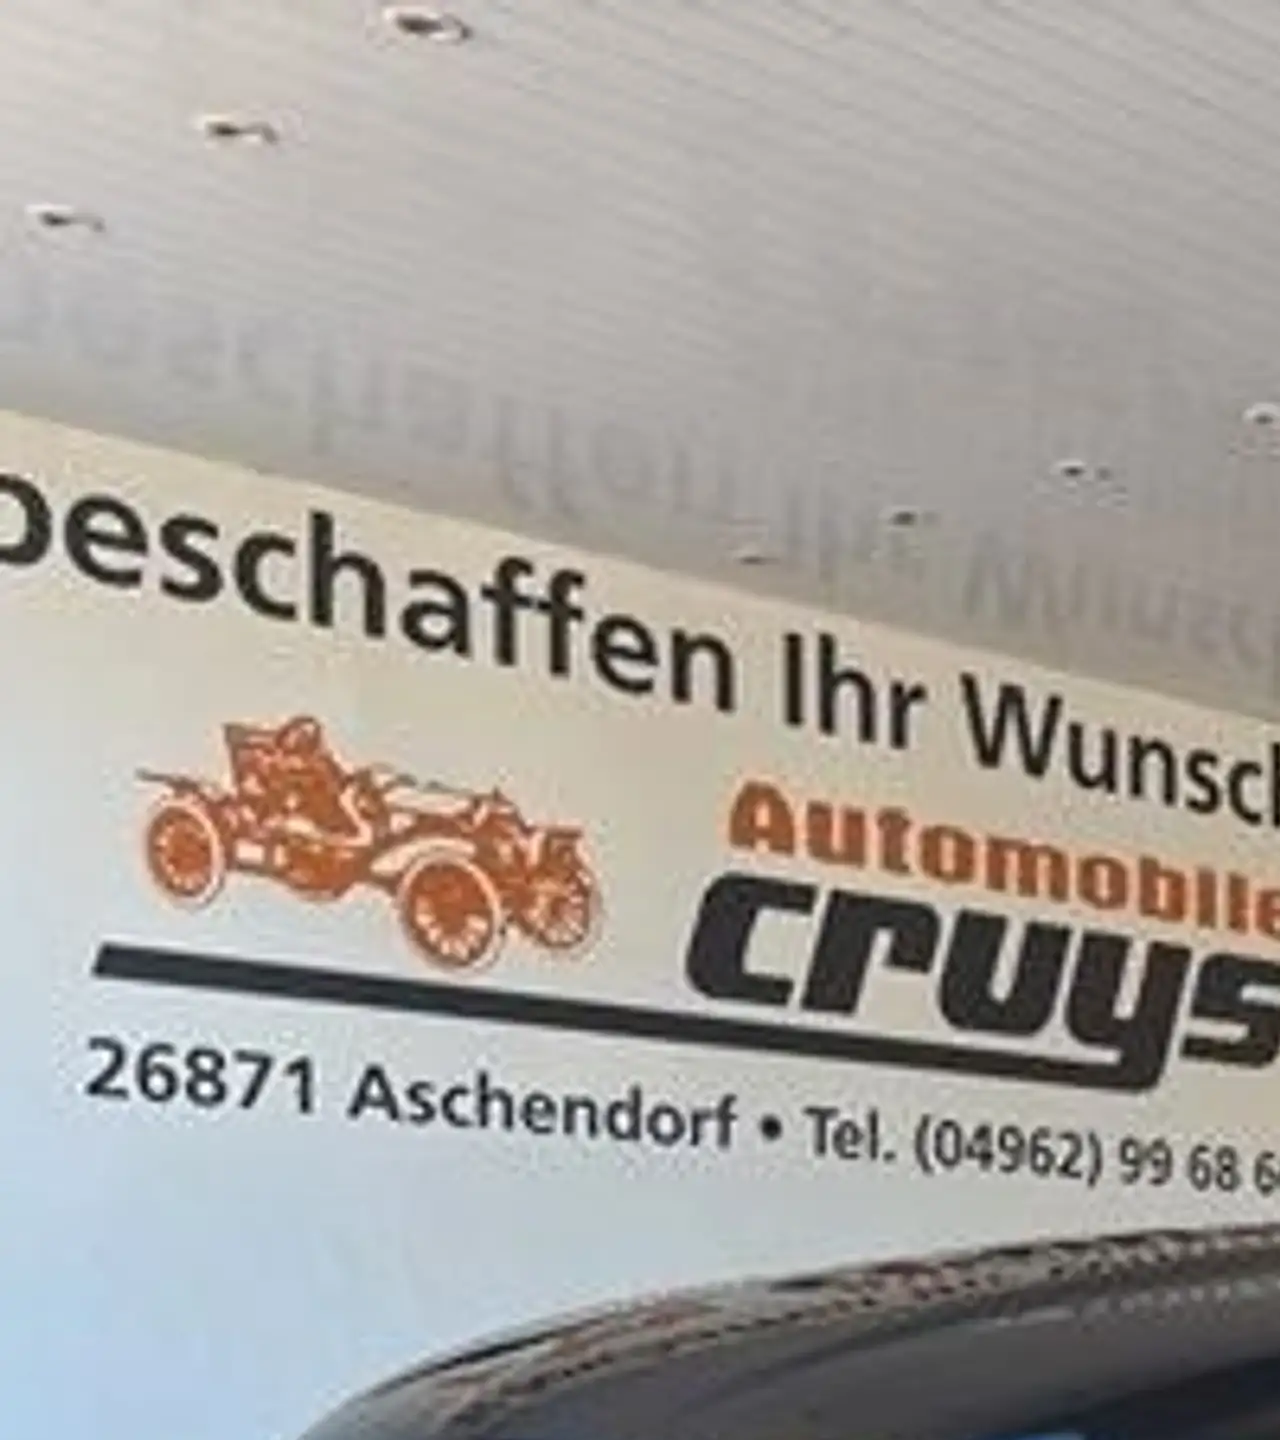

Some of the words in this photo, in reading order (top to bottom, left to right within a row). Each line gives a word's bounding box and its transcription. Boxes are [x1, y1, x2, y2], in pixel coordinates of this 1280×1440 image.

[783, 631, 926, 750] Ihr
[84, 1035, 317, 1114] 26871
[347, 1064, 738, 1150] Aschendorf
[804, 1106, 895, 1163] Tel.
[913, 1114, 1102, 1187] (04962)
[1119, 1138, 1173, 1187] 99
[1186, 1144, 1242, 1194] 68
